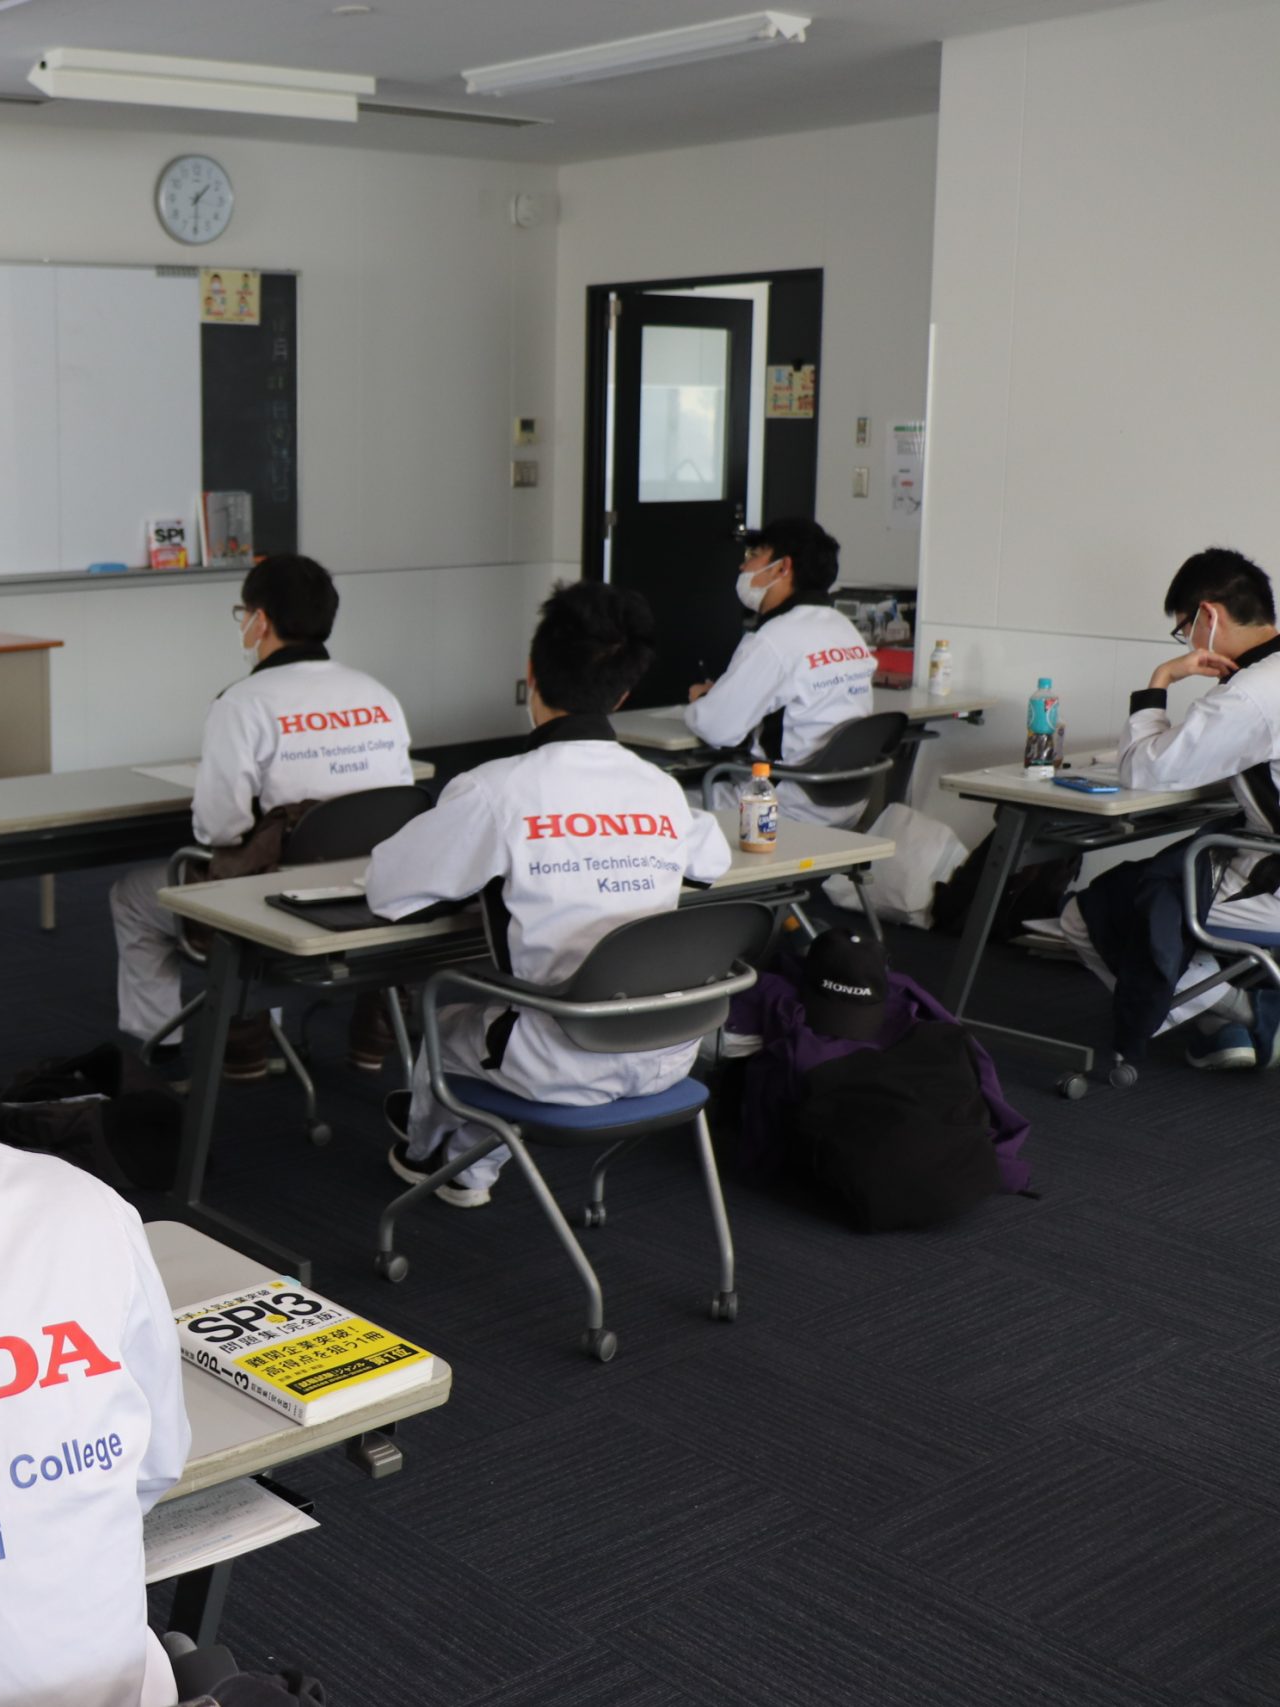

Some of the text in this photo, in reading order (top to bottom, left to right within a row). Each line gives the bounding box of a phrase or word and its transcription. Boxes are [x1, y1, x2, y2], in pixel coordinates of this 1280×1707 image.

[277, 706, 392, 735] HONDA
[280, 748, 319, 762] Honda
[320, 741, 366, 758] Technical
[329, 758, 369, 775] Kansai
[523, 813, 678, 840] HONDA
[529, 859, 580, 876] Honda
[584, 855, 649, 871] Technical
[597, 875, 655, 893] Kansai
[822, 979, 872, 996] HONDA
[188, 1293, 322, 1343] SPI3
[9, 1431, 124, 1490] College
